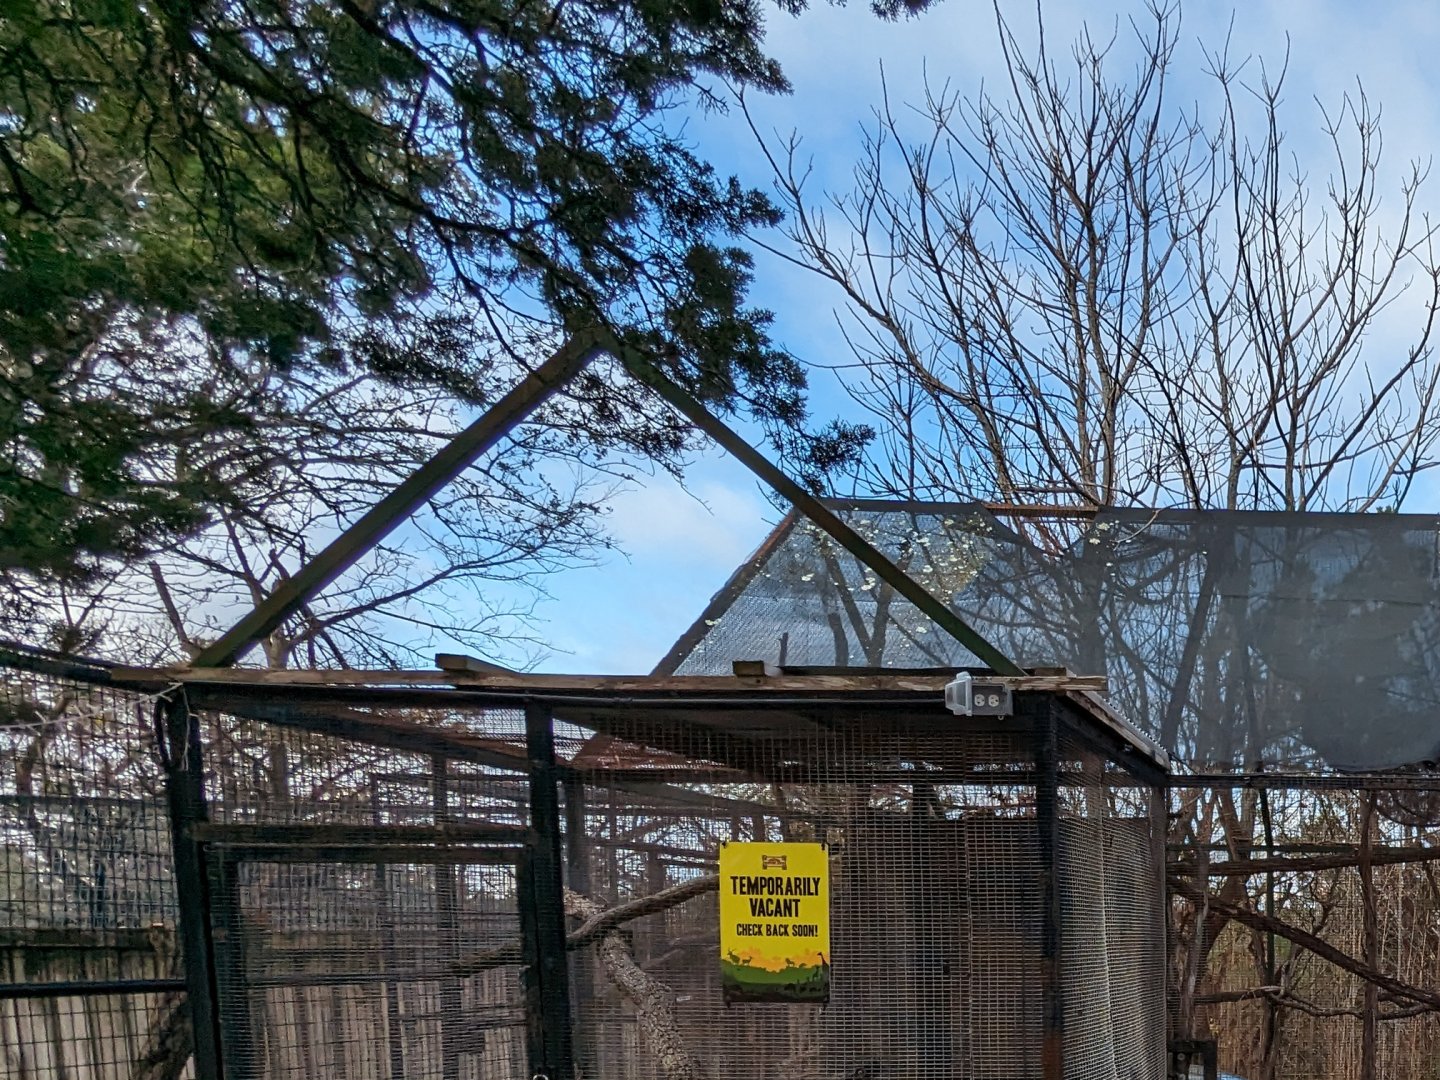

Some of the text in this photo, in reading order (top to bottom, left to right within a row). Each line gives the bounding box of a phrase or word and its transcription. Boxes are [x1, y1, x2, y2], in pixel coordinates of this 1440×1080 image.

[730, 876, 820, 896] TEMPORARILY
[749, 898, 801, 917] VACANT
[736, 923, 818, 937] CHECK BACK SOON!
